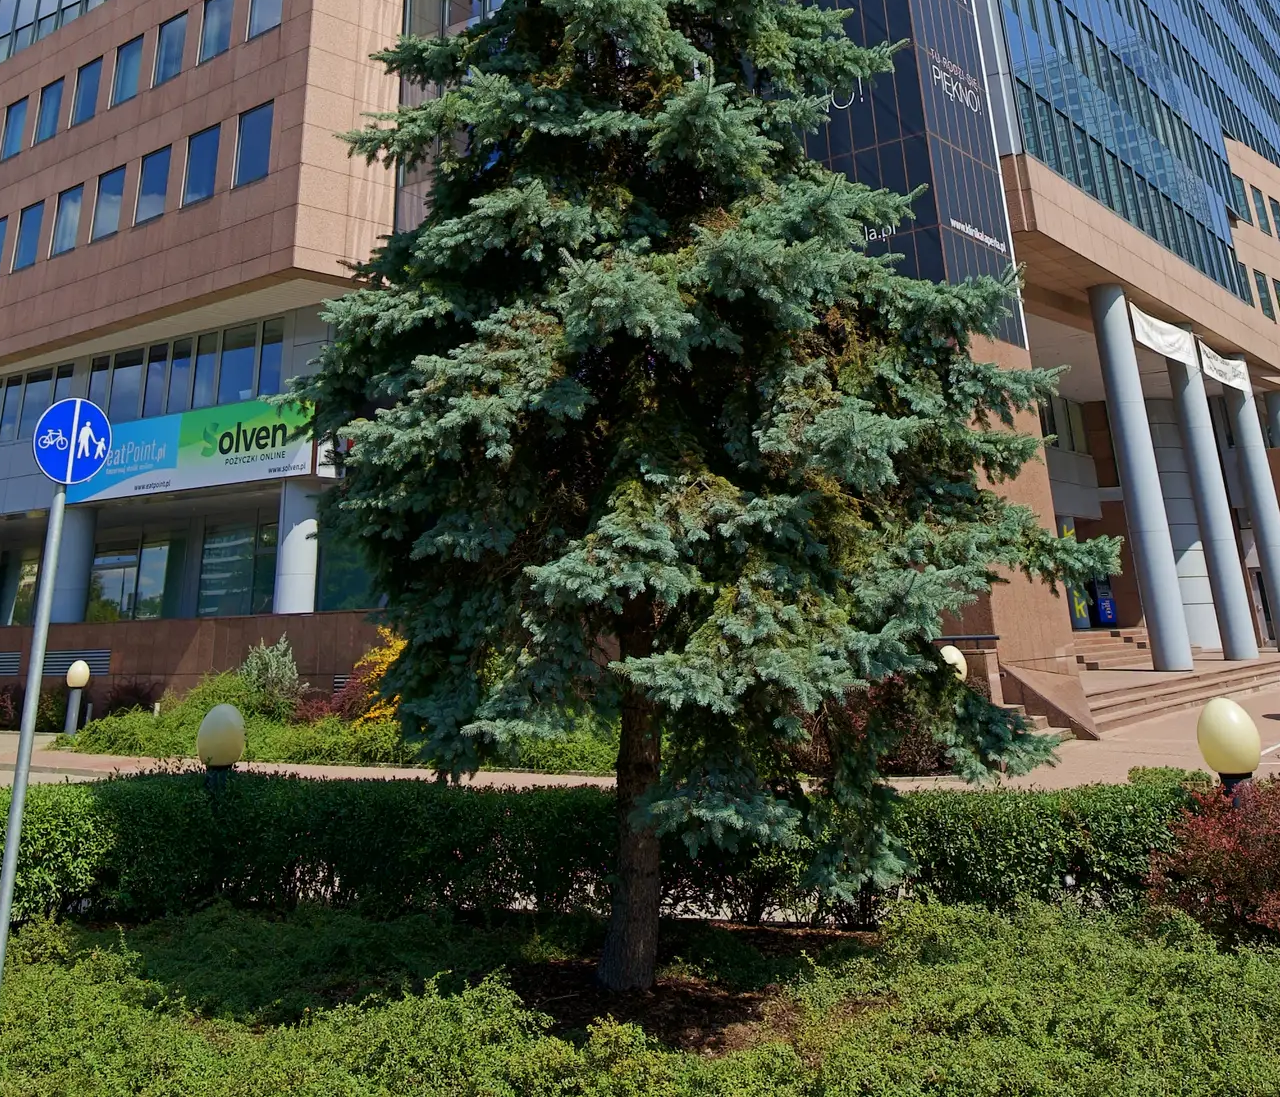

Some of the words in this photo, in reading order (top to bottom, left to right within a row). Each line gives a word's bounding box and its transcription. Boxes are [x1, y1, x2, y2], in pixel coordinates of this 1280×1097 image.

[930, 48, 941, 64] TU
[942, 56, 965, 81] RODZI
[966, 73, 979, 92] SIĘ
[932, 64, 982, 116] PIĘKNO!
[201, 421, 288, 458] Solven
[224, 455, 258, 466] POŻYCZKI
[259, 450, 286, 461] ONLINE
[267, 461, 307, 474] www.solven.pl
[133, 479, 172, 490] www.eatpoint.pl
